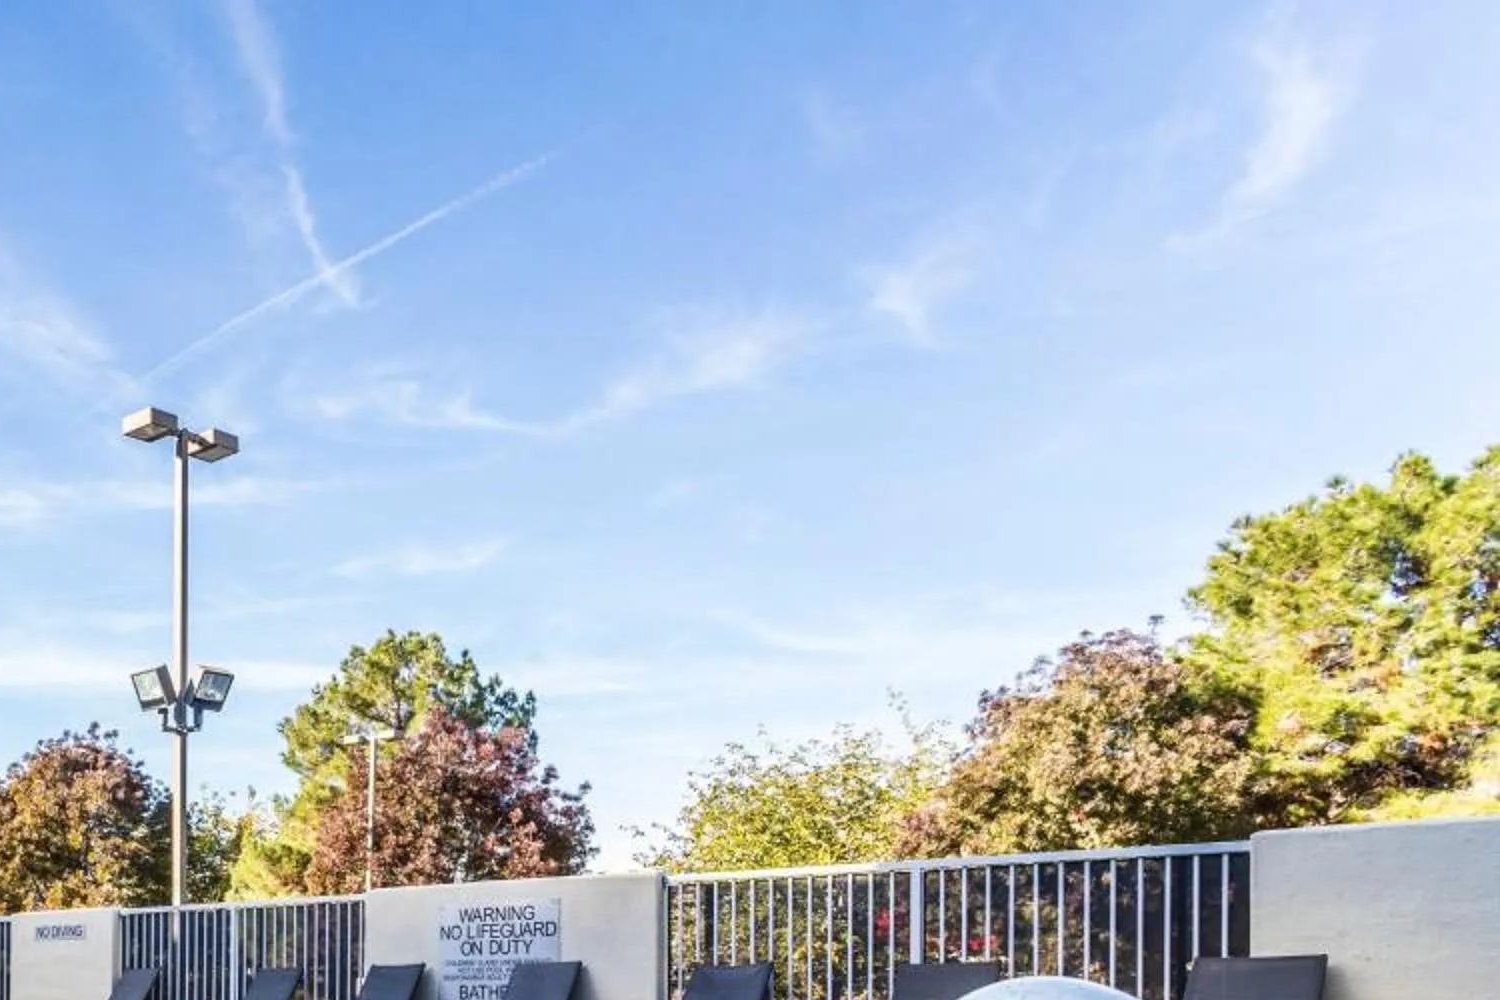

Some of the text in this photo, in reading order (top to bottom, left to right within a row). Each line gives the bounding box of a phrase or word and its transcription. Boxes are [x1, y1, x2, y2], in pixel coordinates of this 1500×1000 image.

[459, 905, 535, 923] WARNING
[36, 925, 83, 938] NO DIVING
[440, 921, 557, 940] NO LIFEGUARD
[460, 939, 533, 957] ON DUTY
